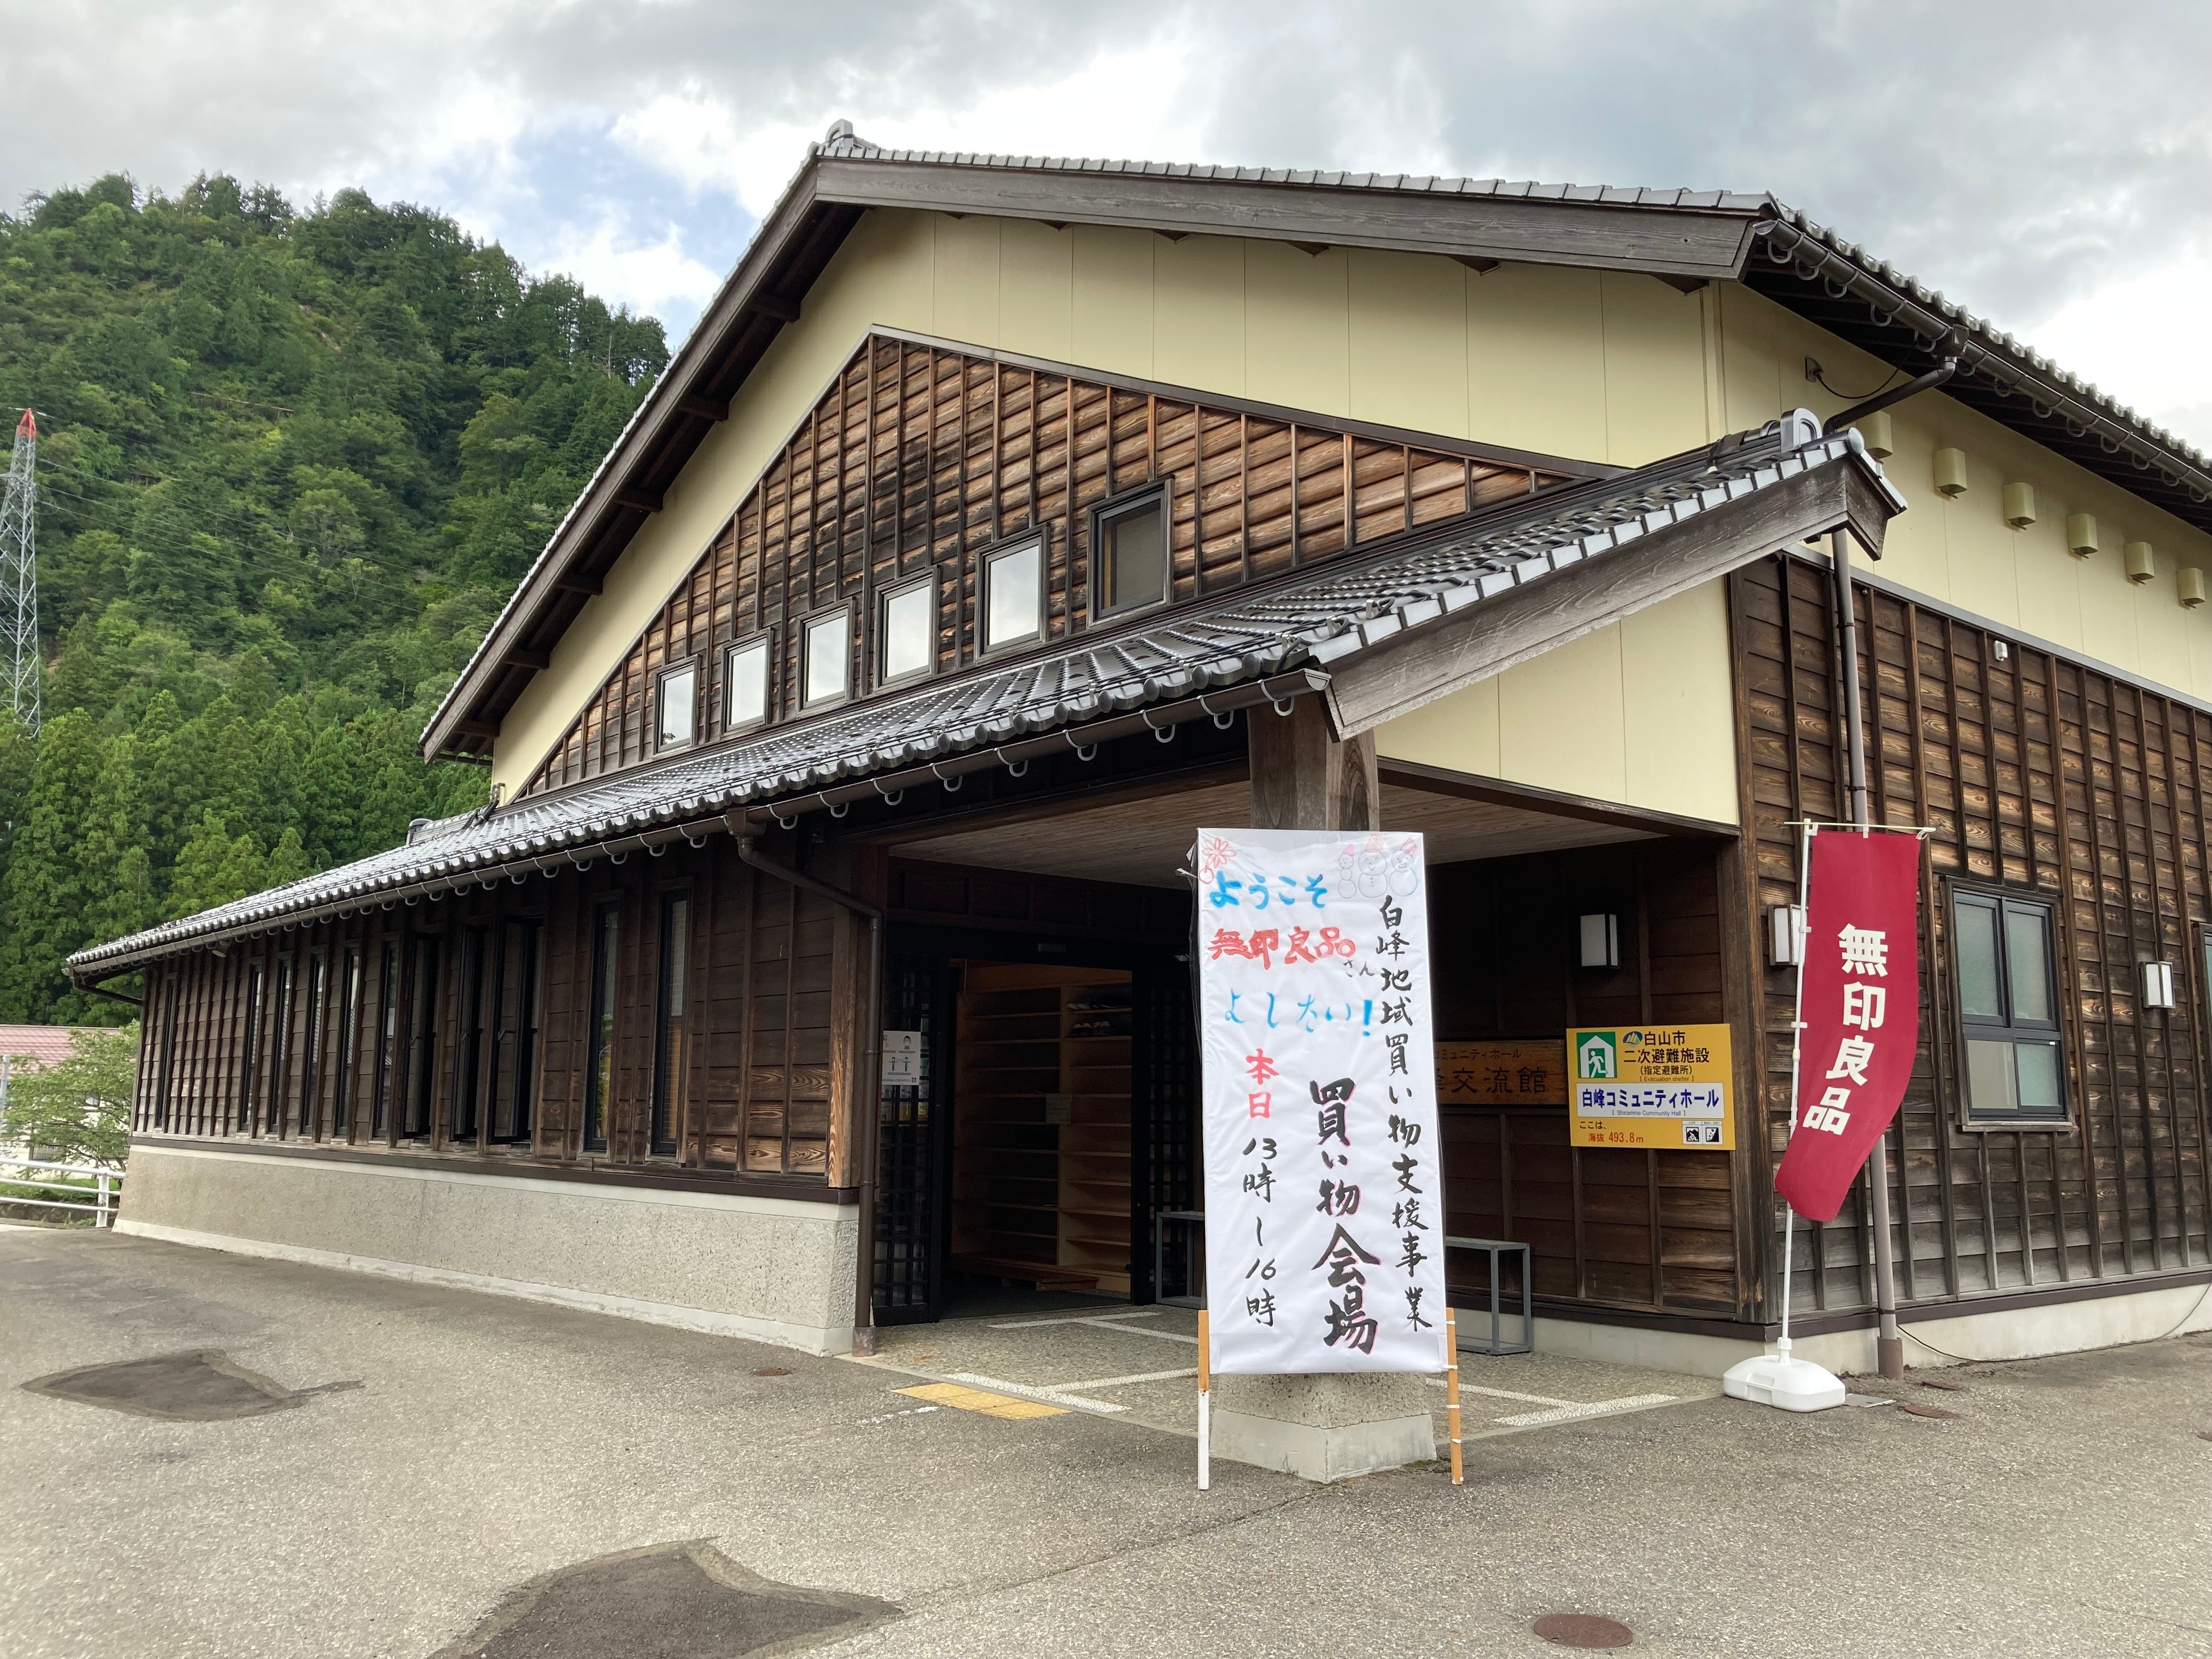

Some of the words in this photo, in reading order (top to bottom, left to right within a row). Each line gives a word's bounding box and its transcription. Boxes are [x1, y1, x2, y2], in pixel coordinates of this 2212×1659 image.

[1209, 871, 1328, 910] ようこそ
[1207, 926, 1356, 970] 無印良品
[1343, 959, 1375, 978] さん
[1644, 1030, 1686, 1046] 白山市
[1802, 923, 1888, 1135] 無印良品
[1623, 1048, 1709, 1063] 二次避難施設
[1640, 1065, 1692, 1075] (指定避難所)
[1246, 1048, 1280, 1119] 本日
[1582, 1088, 1719, 1109] 白峰コミュニティホール
[1375, 894, 1433, 1332] 白峰地域買い物支援事業
[1588, 1133, 1605, 1143] 海抜
[1309, 1077, 1382, 1355] 買い物会場
